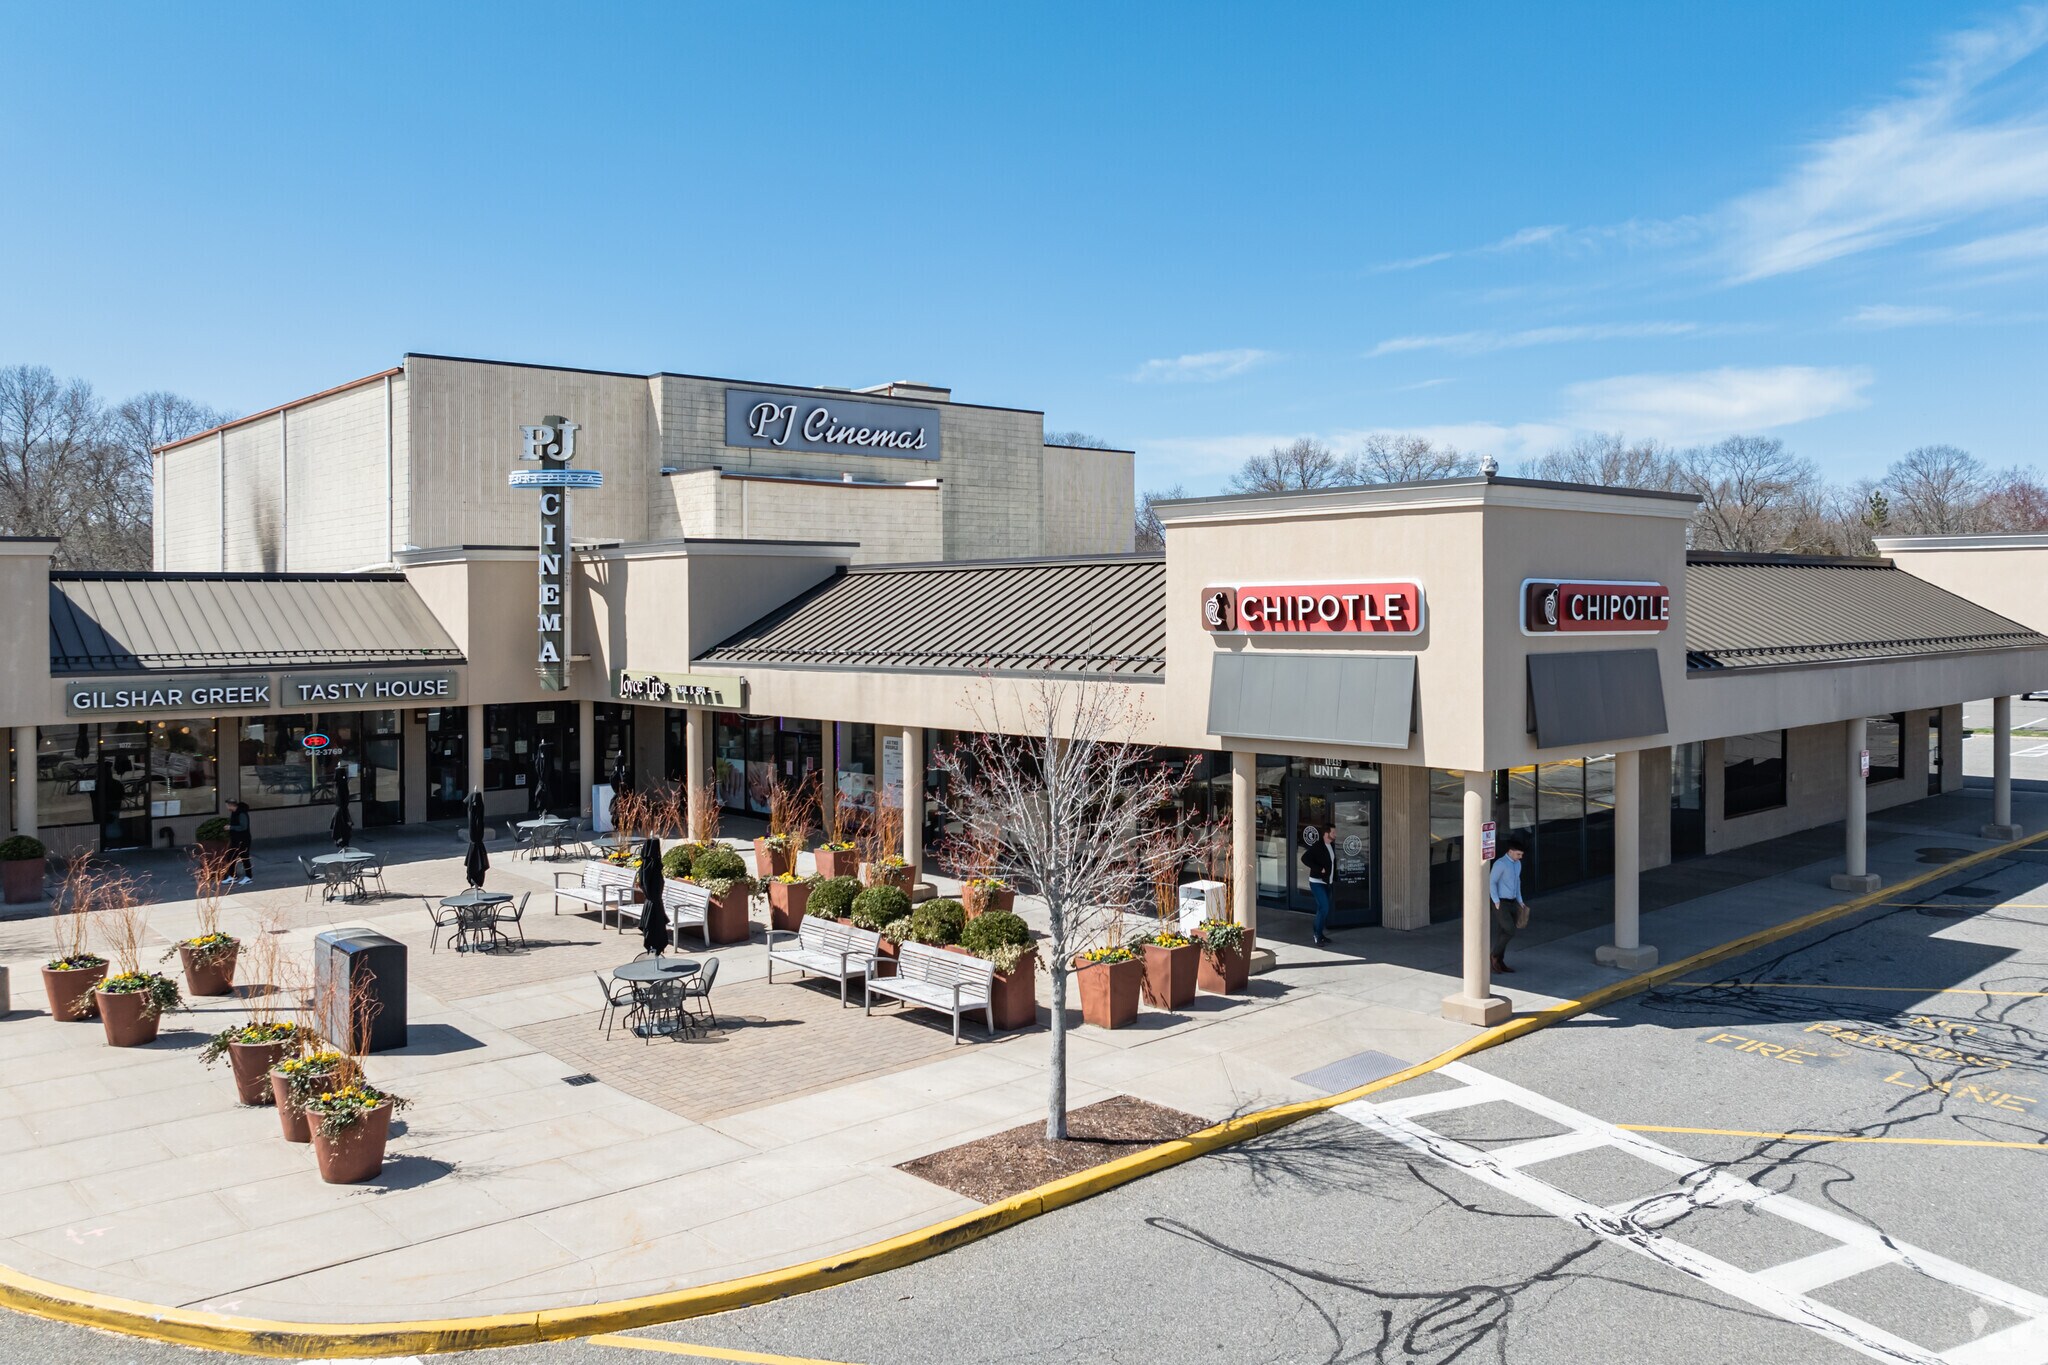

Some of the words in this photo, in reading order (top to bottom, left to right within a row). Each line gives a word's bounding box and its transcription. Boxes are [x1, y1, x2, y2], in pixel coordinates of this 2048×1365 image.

[749, 402, 798, 446] PJ
[803, 407, 928, 450] Cinemas
[519, 423, 582, 461] PJ
[547, 473, 595, 484] PLAZA
[537, 493, 562, 663] CINEMA
[1240, 593, 1402, 622] CHIPOTLE
[1571, 594, 1670, 621] CHIPOTLE
[73, 689, 183, 710] GILSHAR
[191, 686, 270, 705] GREEK
[299, 682, 369, 701] TASTY
[375, 679, 449, 698] HOUSE
[620, 673, 643, 696] Joyce
[645, 675, 666, 699] Tips
[1313, 764, 1341, 778] UNIT
[1343, 767, 1352, 779] A
[1704, 1033, 1819, 1065] FIRE
[1882, 1070, 2038, 1113] LANE
